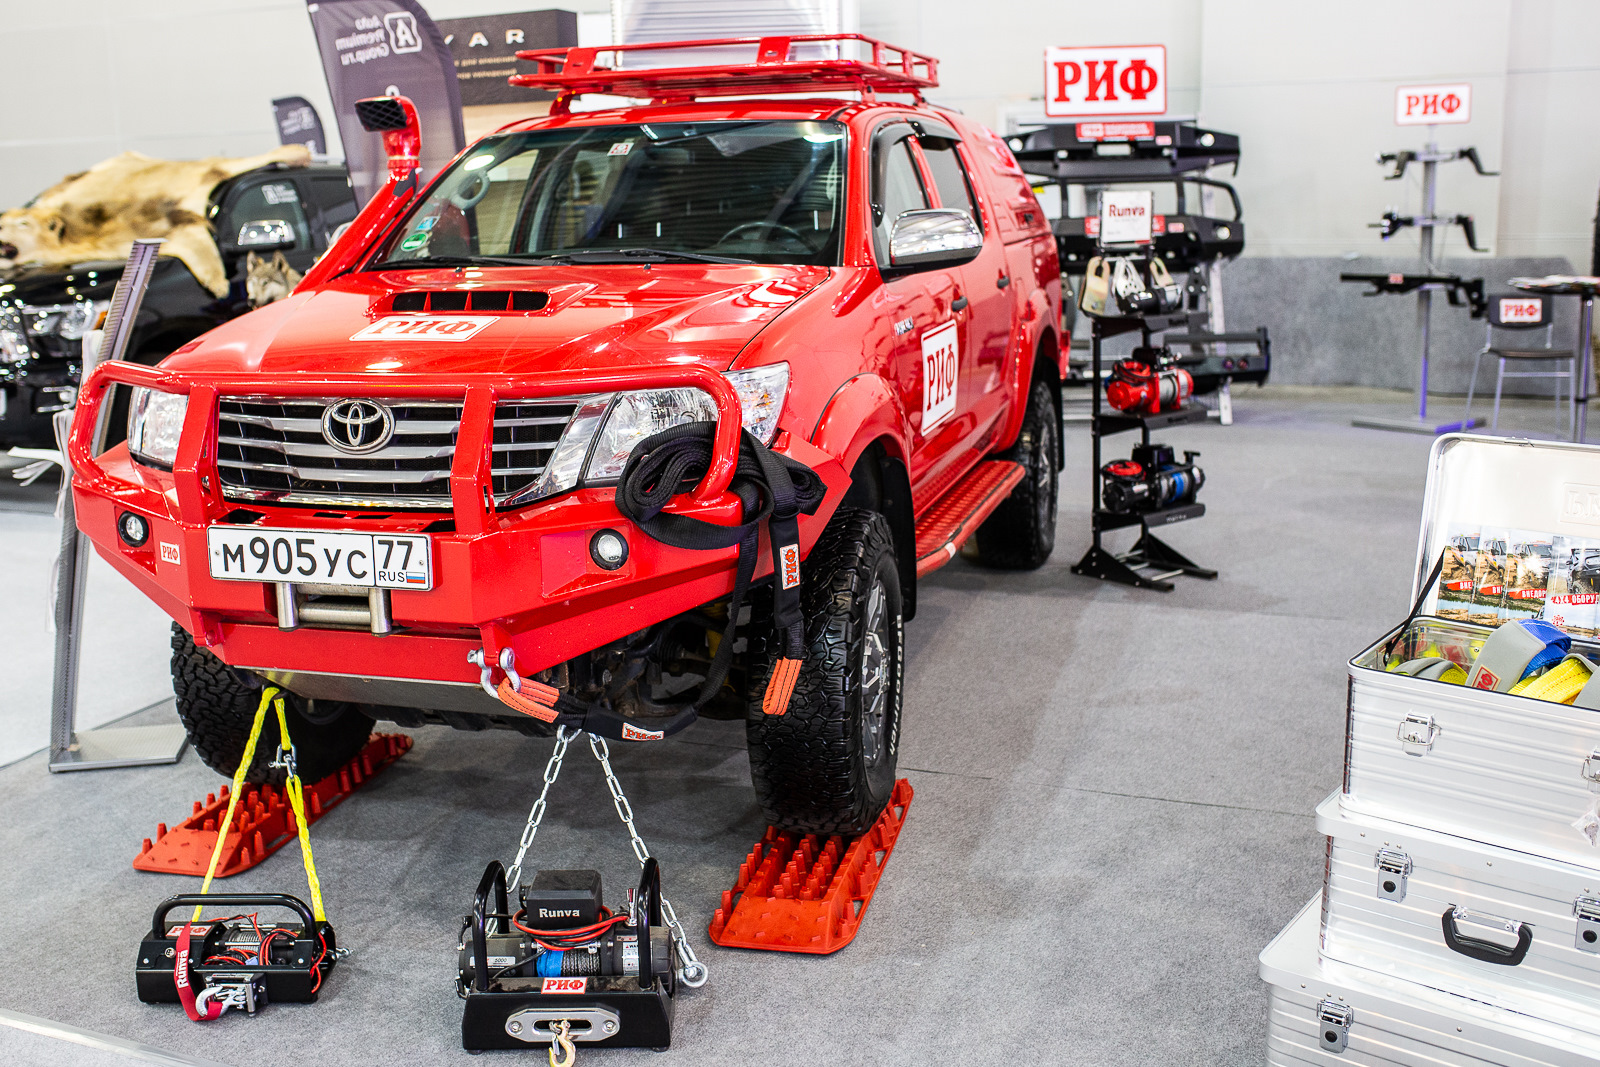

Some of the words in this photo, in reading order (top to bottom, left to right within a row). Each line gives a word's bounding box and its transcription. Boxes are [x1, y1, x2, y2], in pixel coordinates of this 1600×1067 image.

[1053, 59, 1158, 102] РИФ
[1405, 93, 1461, 115] РИФ
[1109, 204, 1145, 217] Runva
[1504, 303, 1538, 317] РИФ
[367, 320, 478, 335] РИФ
[926, 343, 956, 412] РИФ
[162, 544, 179, 561] РИФ
[222, 536, 368, 579] М905УС
[377, 539, 414, 571] 77
[785, 548, 797, 585] РИФ
[379, 571, 405, 583] RUS
[539, 908, 581, 918] Runva
[170, 926, 207, 934] РФ
[176, 949, 189, 989] Runva
[545, 979, 584, 991] РИФ
